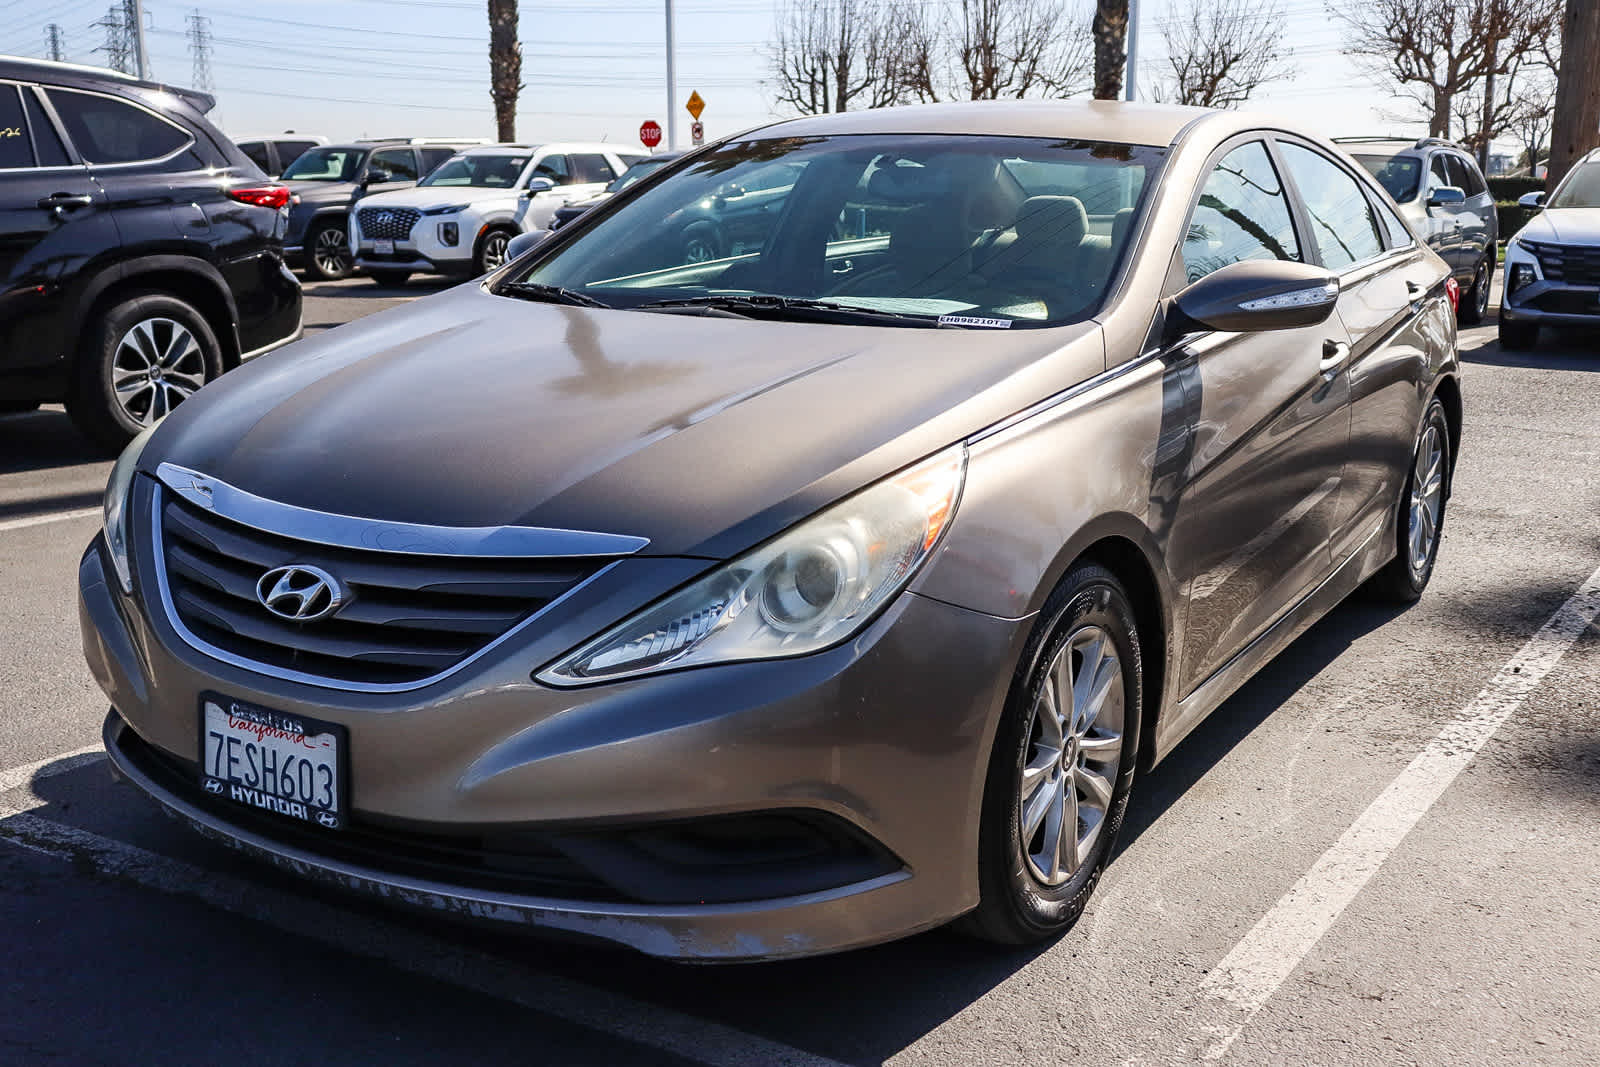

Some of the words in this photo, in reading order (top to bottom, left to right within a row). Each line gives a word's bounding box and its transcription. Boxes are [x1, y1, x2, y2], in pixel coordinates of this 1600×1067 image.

[641, 128, 661, 140] STOP
[209, 731, 334, 810] 7ESH603
[231, 785, 309, 821] HYUNDAI
